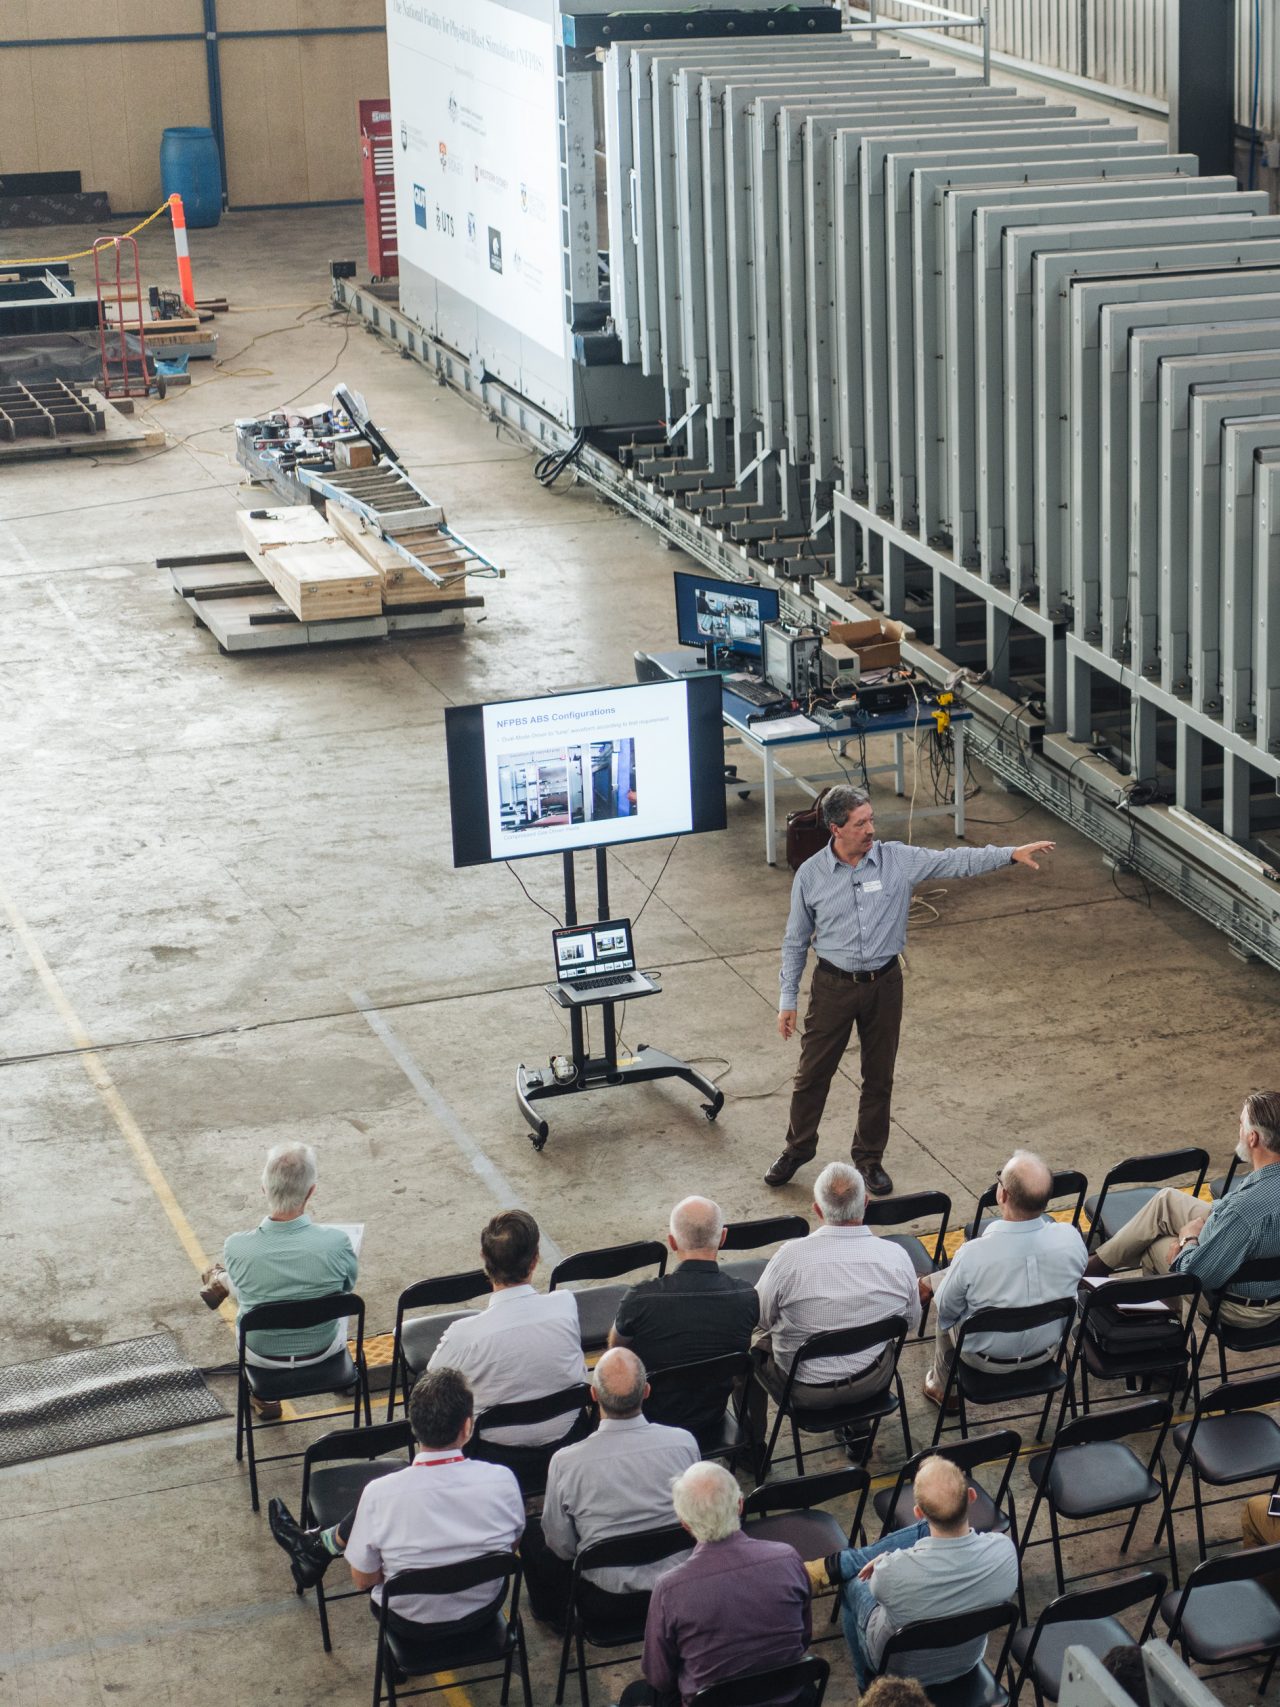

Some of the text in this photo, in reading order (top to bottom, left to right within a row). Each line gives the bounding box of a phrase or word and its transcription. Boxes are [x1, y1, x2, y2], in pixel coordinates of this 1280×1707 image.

[441, 211, 454, 238] UTS
[496, 706, 616, 728] NFPBS ABS Configurations
